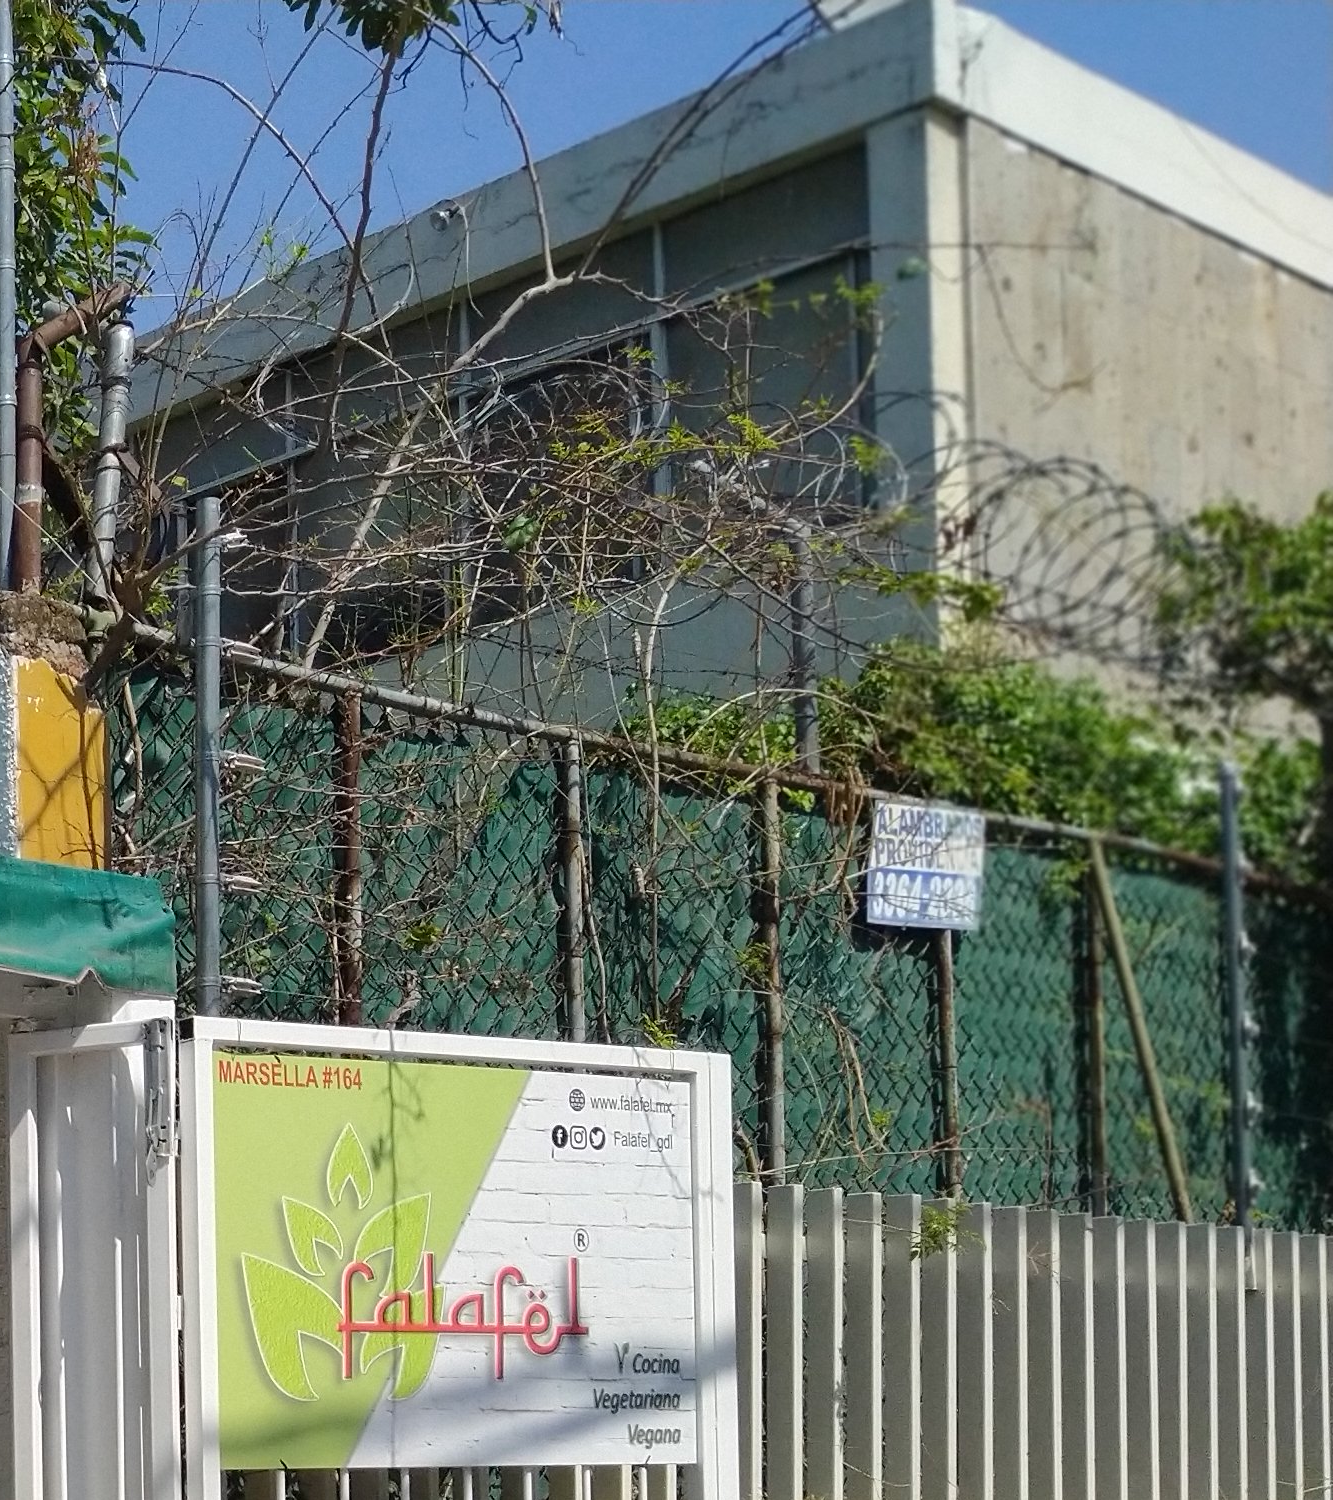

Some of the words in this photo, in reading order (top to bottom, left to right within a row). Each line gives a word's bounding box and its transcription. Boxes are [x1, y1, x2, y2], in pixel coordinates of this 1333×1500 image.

[218, 1060, 318, 1089] MARSELLA
[322, 1068, 363, 1091] #164
[590, 1095, 672, 1114] www.falafel.mx
[614, 1131, 673, 1153] Falafel_gdl
[632, 1353, 681, 1374] Cocina
[593, 1389, 682, 1414] Vegetariana
[627, 1424, 682, 1446] Vegana
